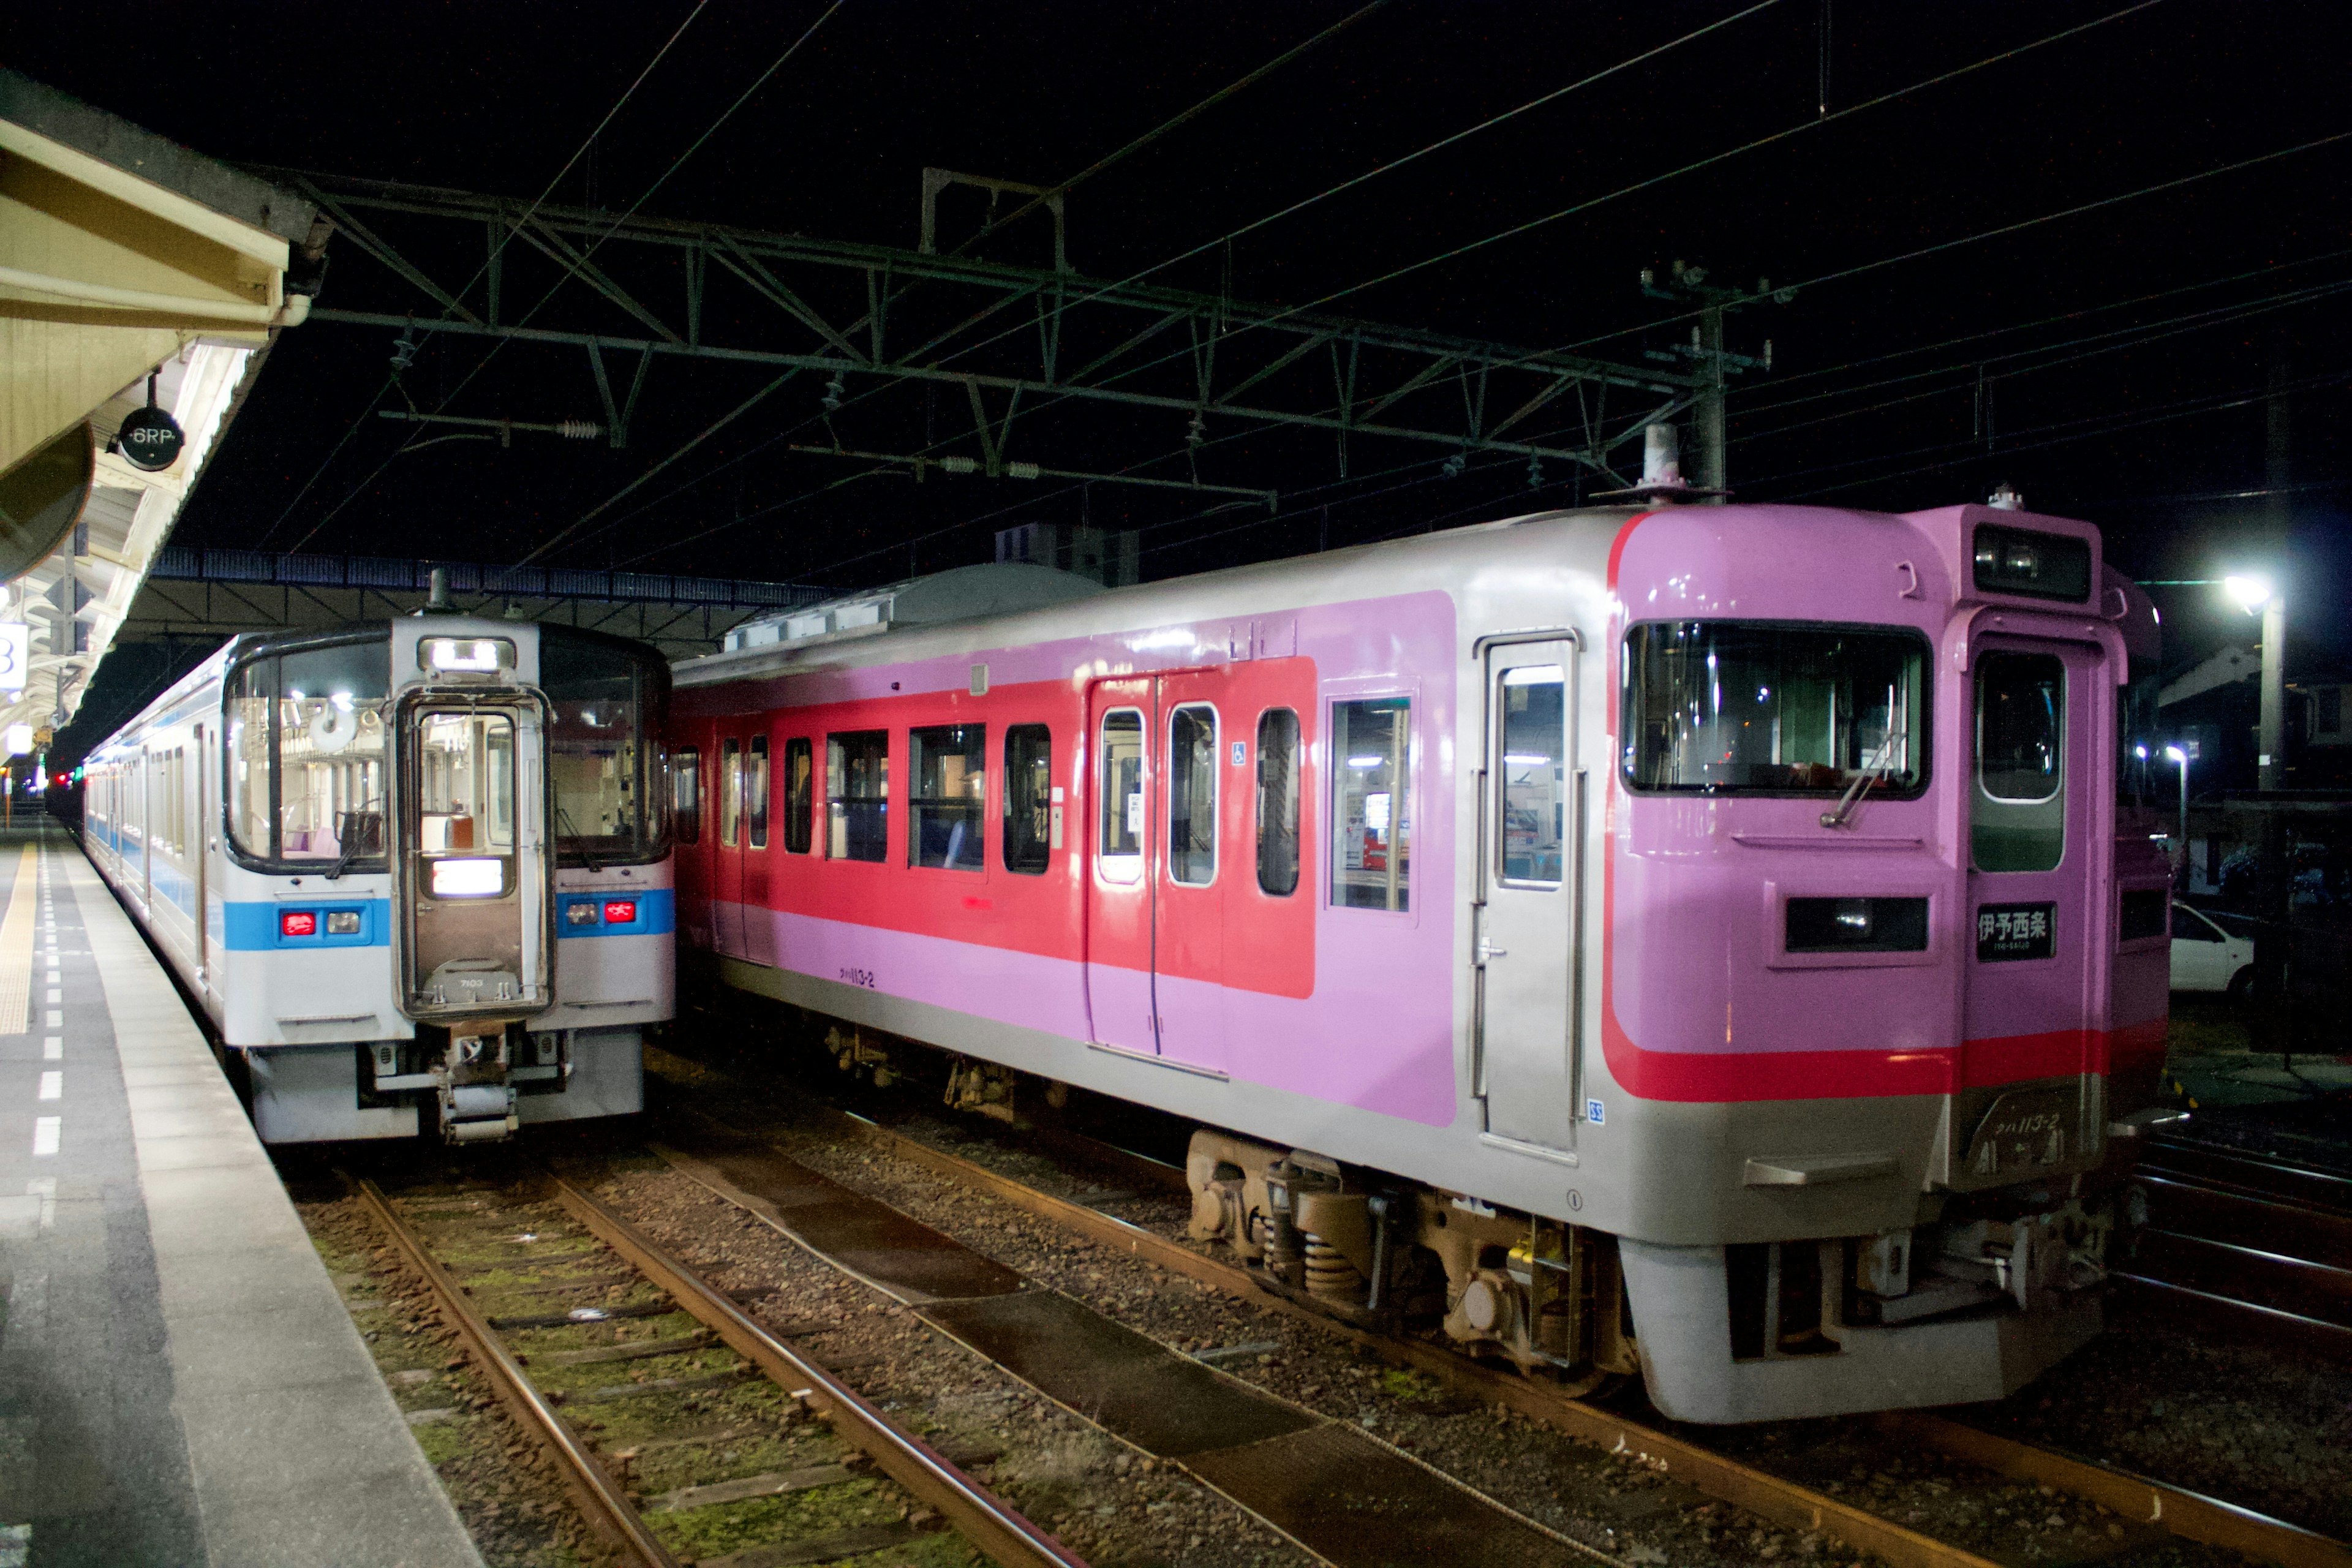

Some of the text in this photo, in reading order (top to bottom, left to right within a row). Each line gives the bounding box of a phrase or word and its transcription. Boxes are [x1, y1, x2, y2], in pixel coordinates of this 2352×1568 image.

[134, 428, 173, 444] 6RP
[1978, 911, 2046, 941] 伊予西条
